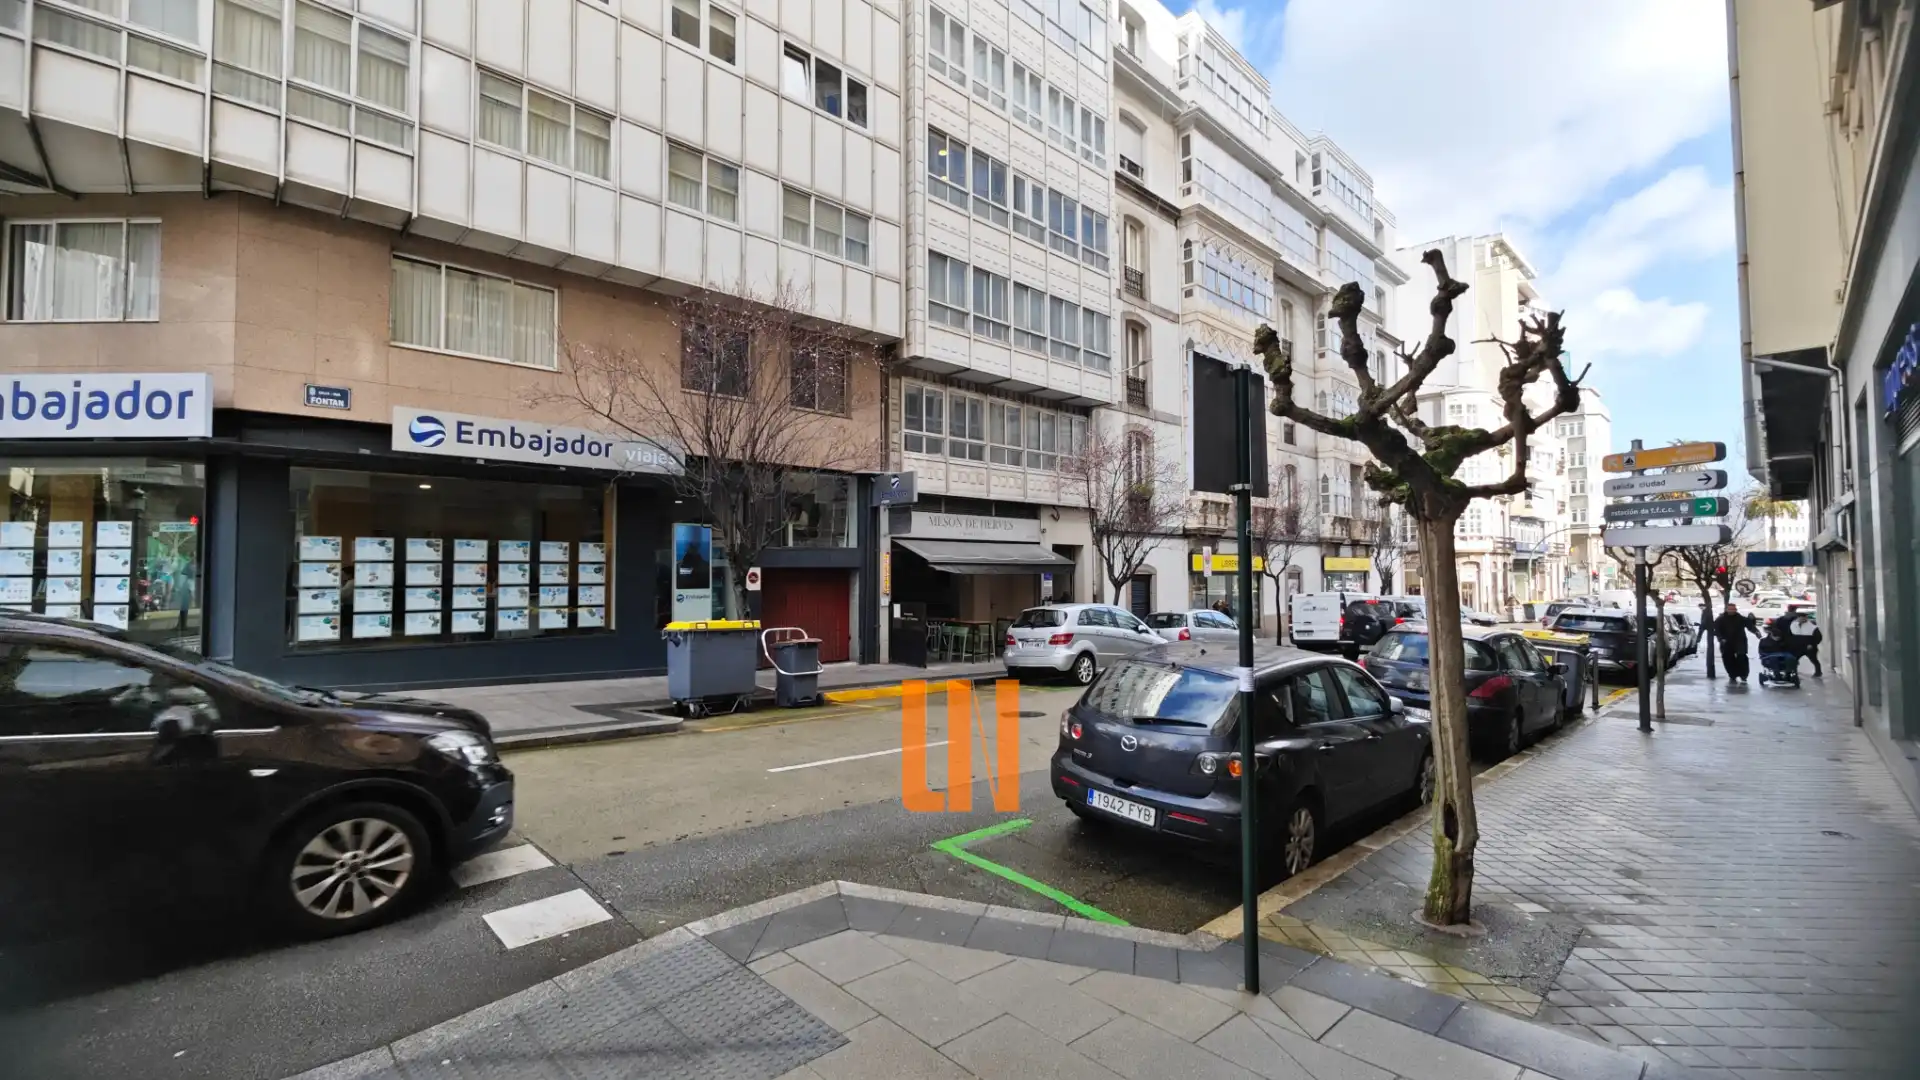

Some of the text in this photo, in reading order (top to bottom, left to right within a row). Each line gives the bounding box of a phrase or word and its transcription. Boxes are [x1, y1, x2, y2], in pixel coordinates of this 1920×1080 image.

[0, 380, 194, 430] bajador
[456, 420, 613, 458] Embajador
[1639, 480, 1665, 488] ciudad
[1097, 793, 1151, 821] 1942 FYB
